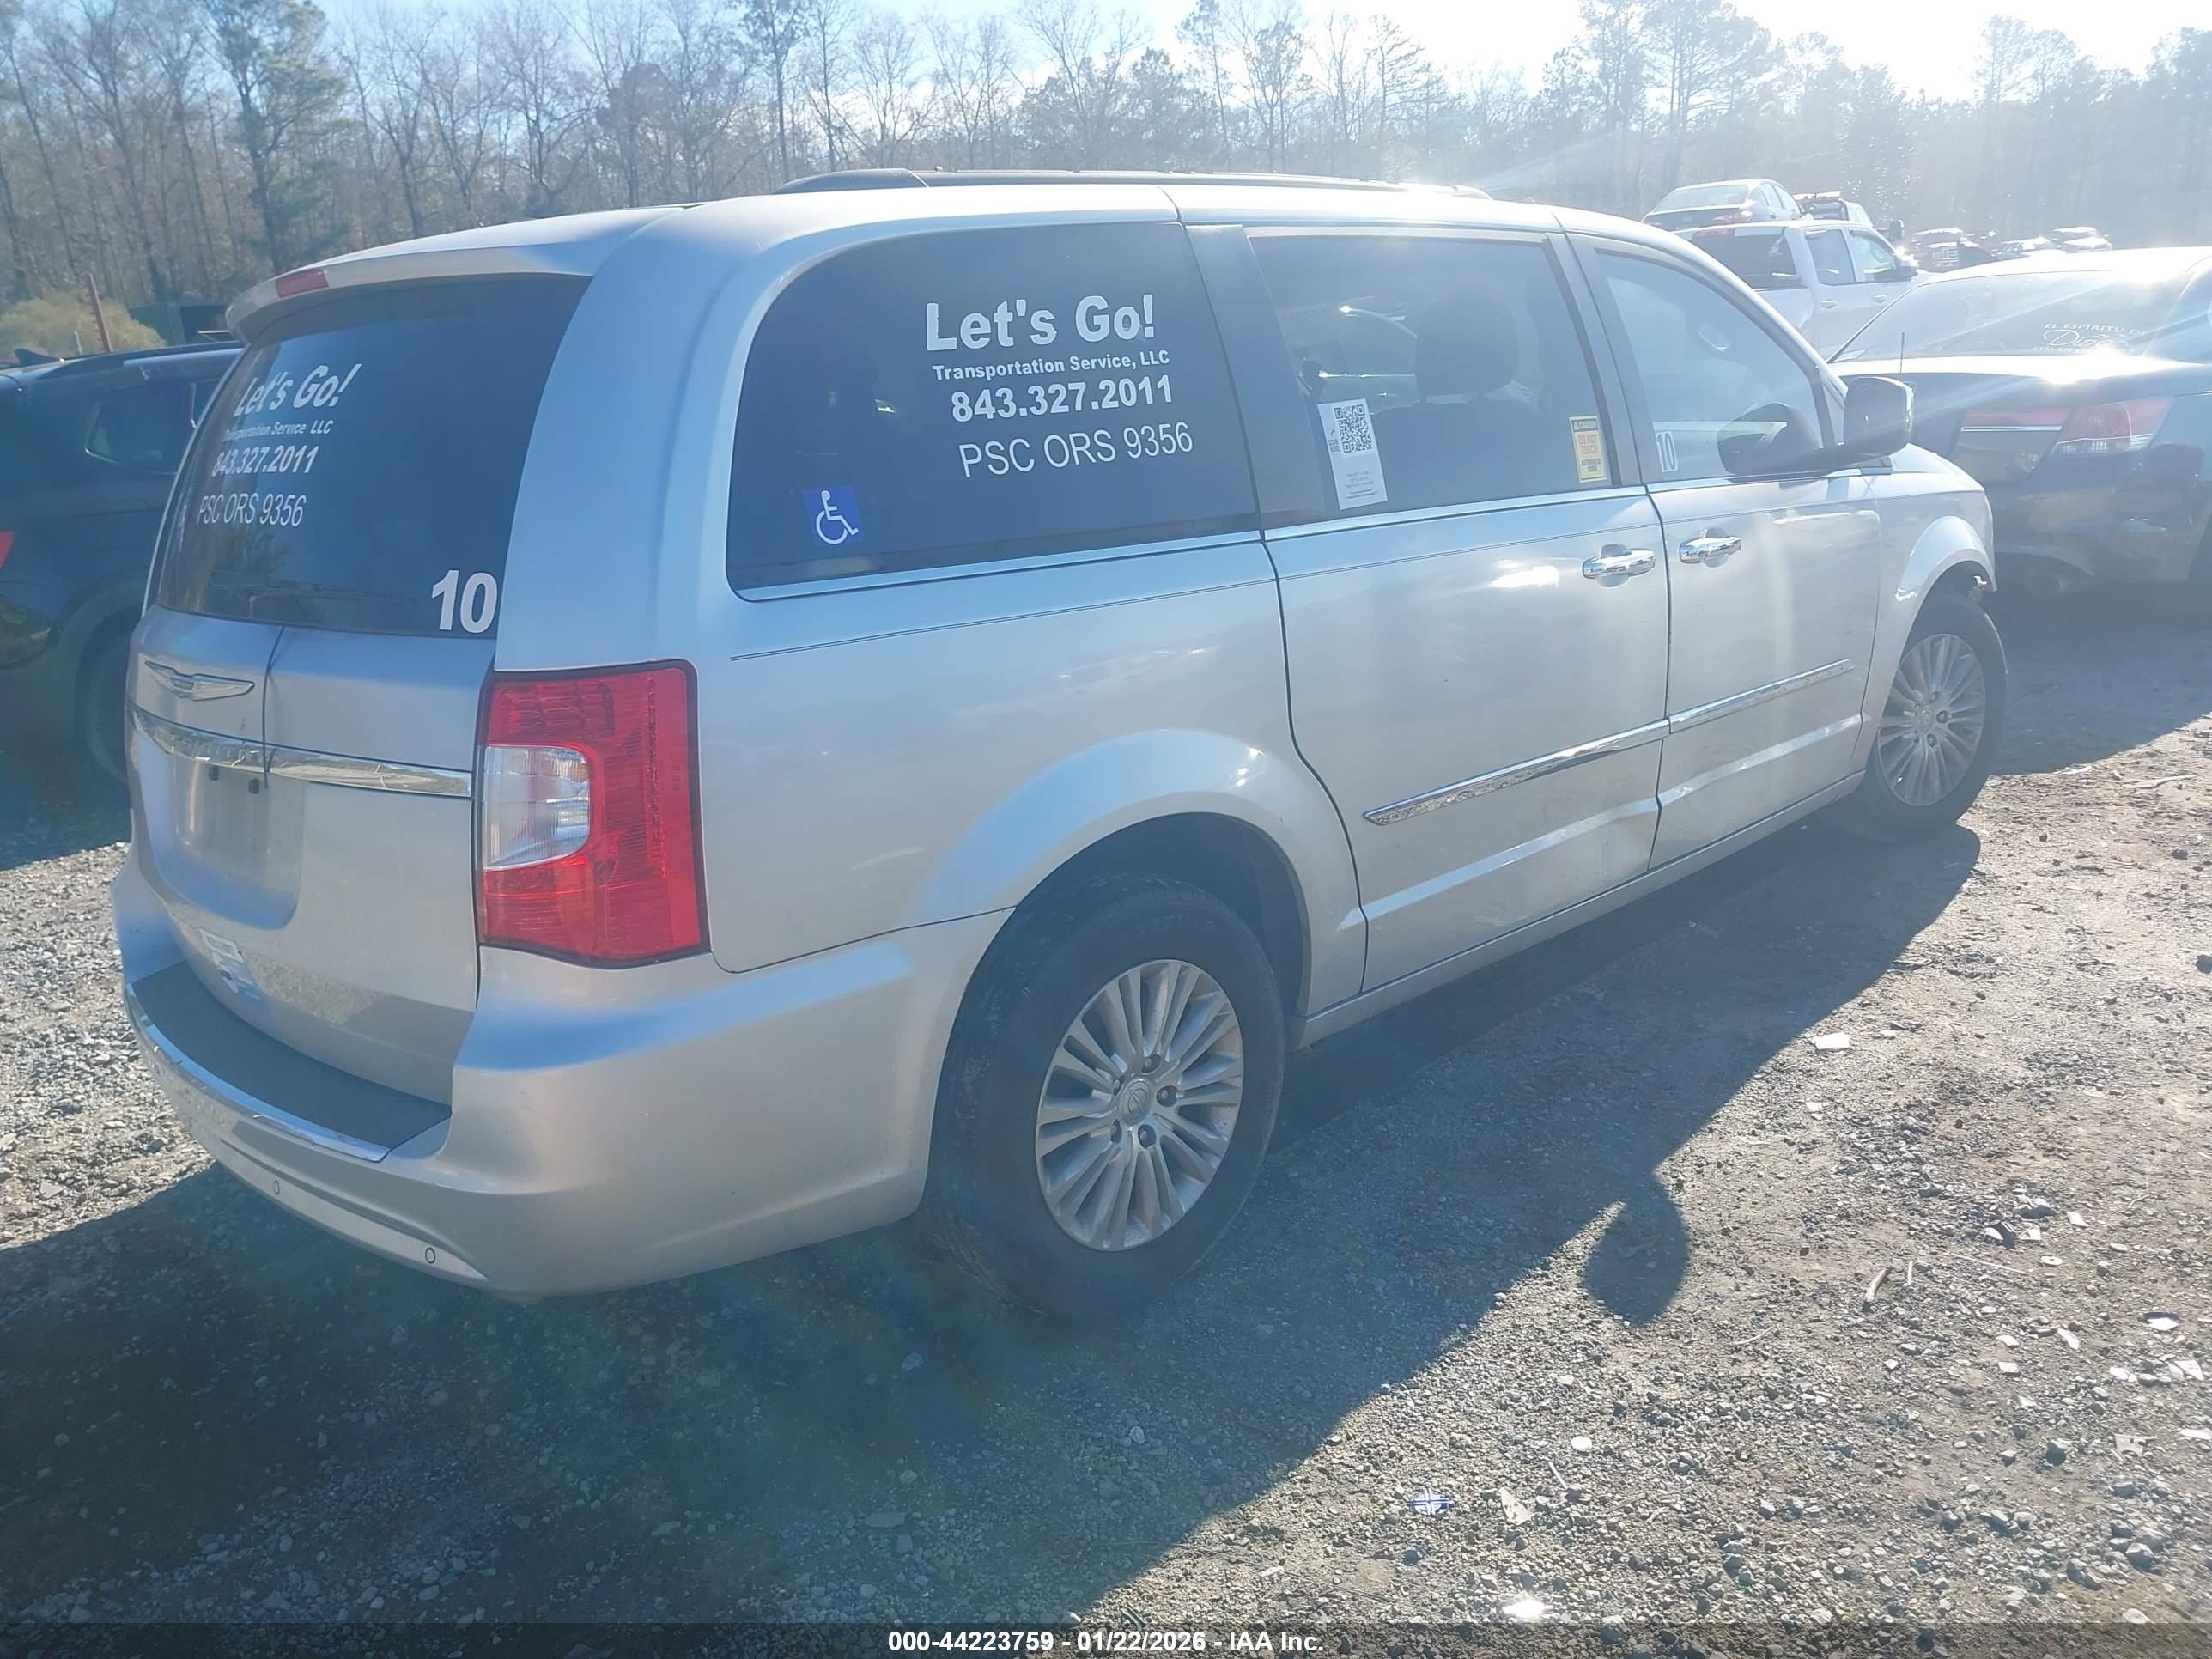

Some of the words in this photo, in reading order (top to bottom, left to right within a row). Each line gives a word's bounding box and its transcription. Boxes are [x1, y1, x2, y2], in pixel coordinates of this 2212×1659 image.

[926, 299, 1057, 351] Let's
[1075, 294, 1154, 343] Go!
[932, 358, 1065, 380] Transportation
[1070, 353, 1136, 371] Service,
[1139, 349, 1170, 366] LLC
[234, 372, 294, 417] Let's
[293, 363, 362, 408] Go!
[951, 374, 1173, 422] 843.327.2011
[271, 422, 307, 435] Service
[310, 420, 334, 434] LLC
[211, 445, 319, 477] 843.327.2011
[958, 438, 1035, 478] PSC
[1043, 429, 1116, 468] ORS
[1122, 422, 1193, 459] 9356
[1656, 432, 1678, 472] 10
[196, 494, 223, 525] PSC
[223, 492, 259, 525] ORS
[259, 492, 307, 527] 9356
[431, 569, 498, 634] 10
